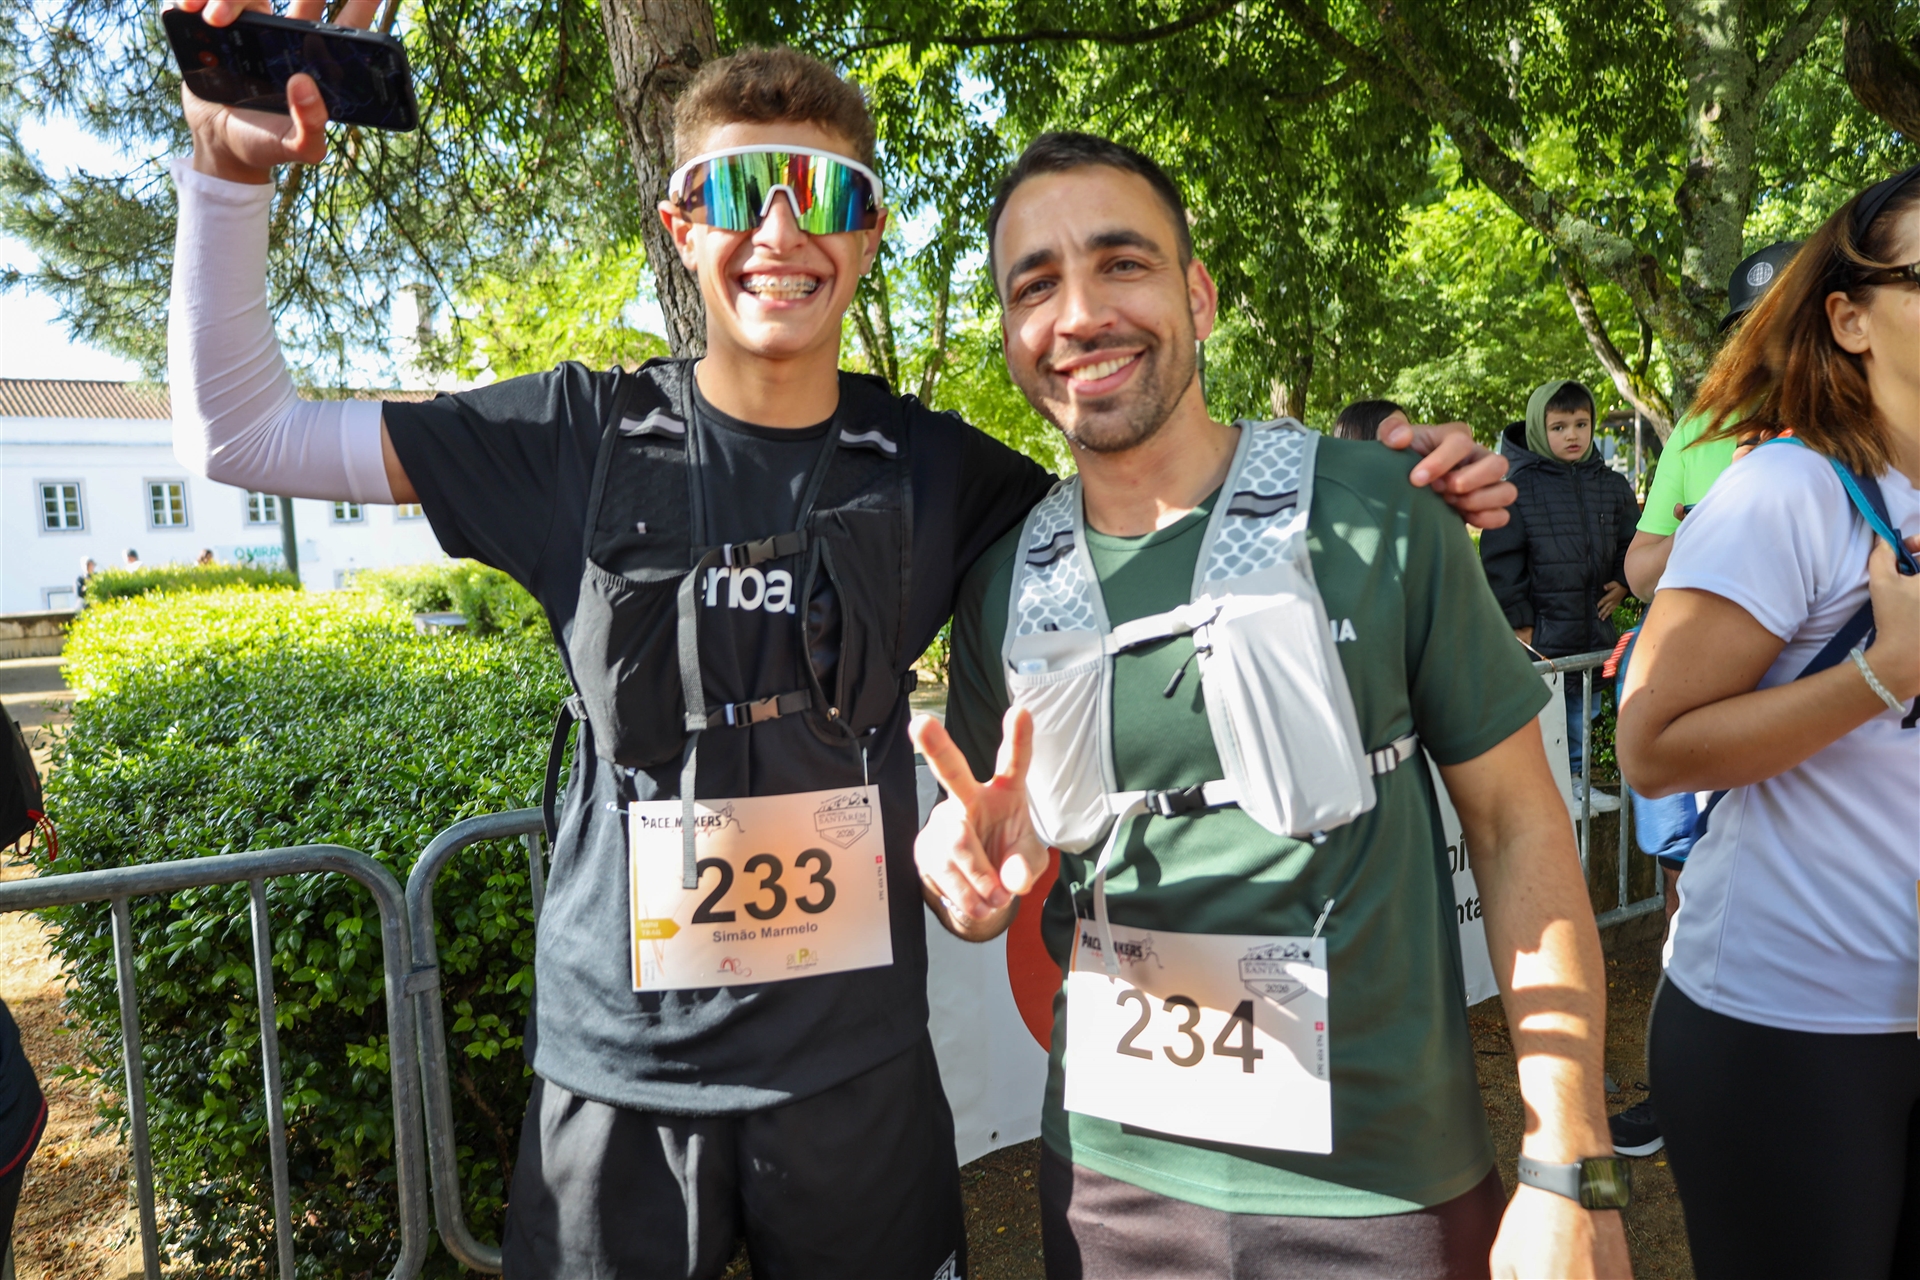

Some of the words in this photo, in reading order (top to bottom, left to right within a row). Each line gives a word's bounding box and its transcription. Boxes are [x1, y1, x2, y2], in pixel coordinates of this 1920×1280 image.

[674, 815, 721, 830] MKERS
[691, 848, 836, 924] 233
[713, 929, 757, 943] Simão
[761, 922, 818, 938] Marmelo
[1116, 989, 1263, 1073] 234
